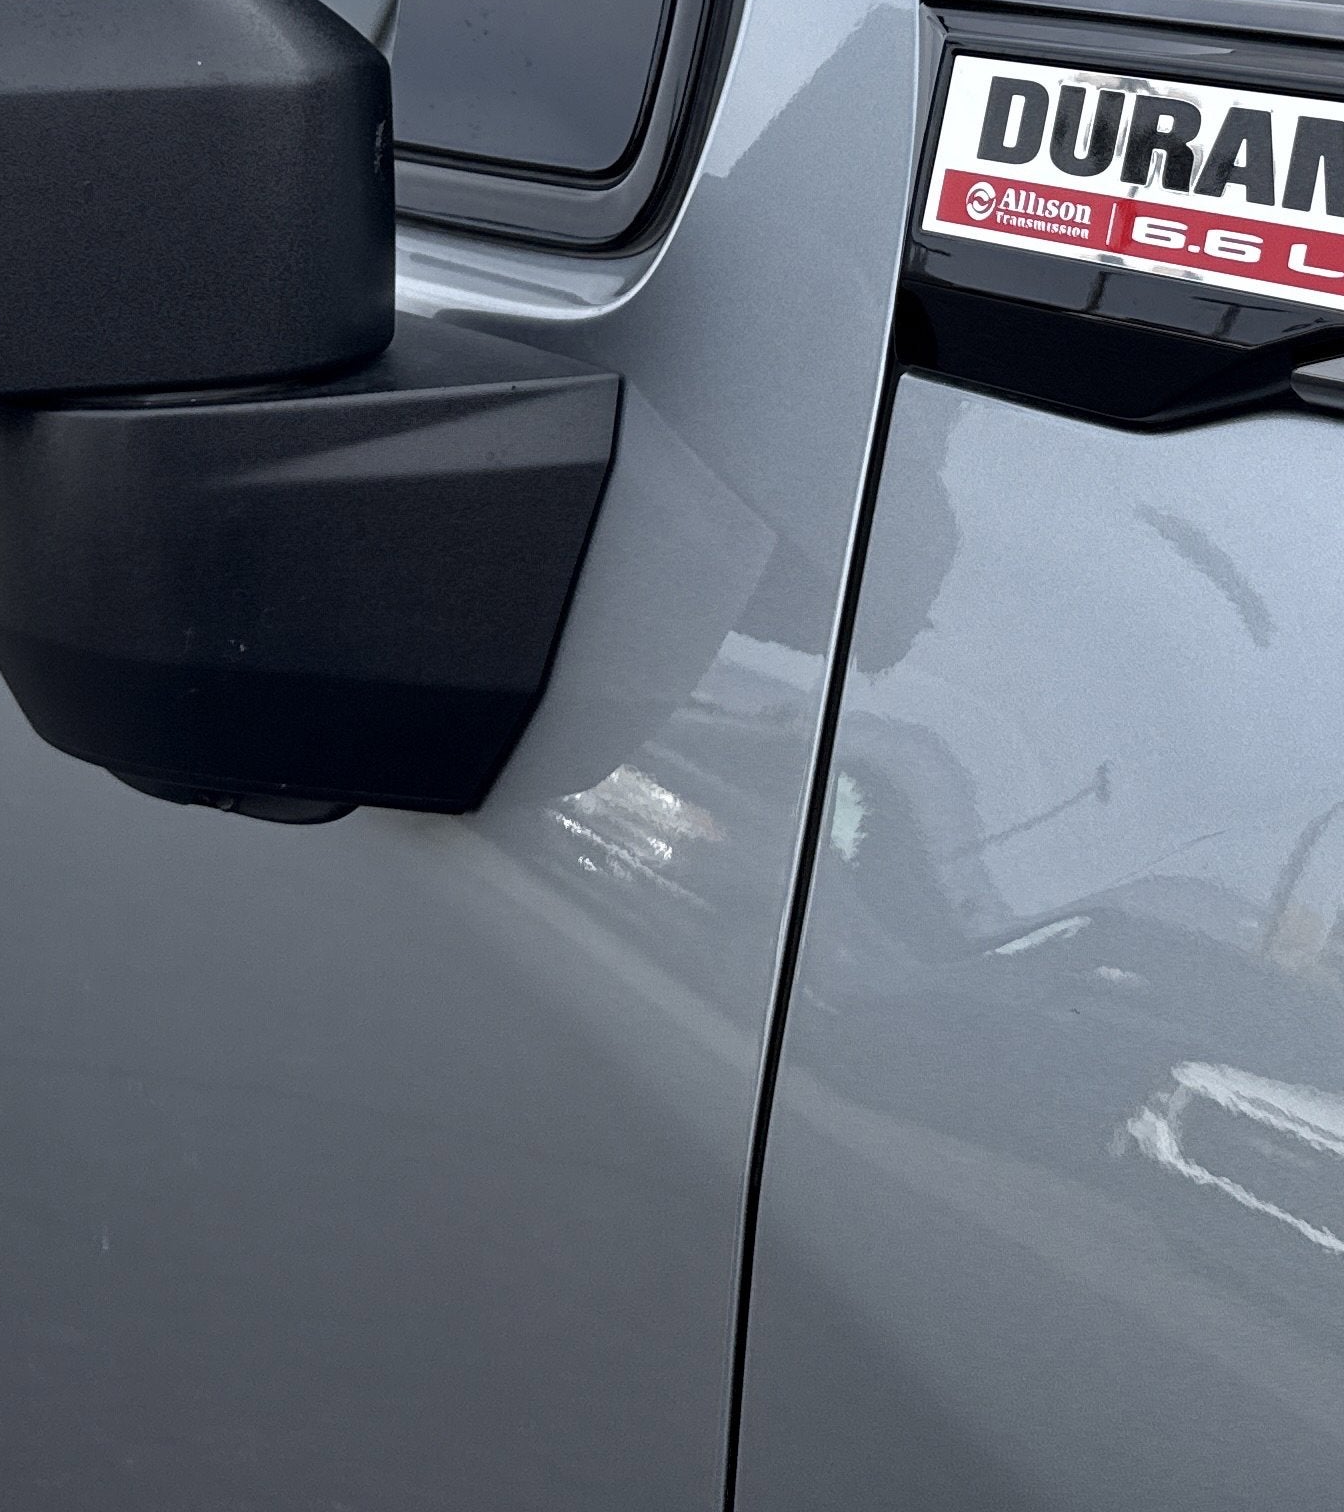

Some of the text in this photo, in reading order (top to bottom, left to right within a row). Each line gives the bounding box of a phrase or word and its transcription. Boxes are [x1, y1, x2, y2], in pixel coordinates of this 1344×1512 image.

[995, 212, 1090, 240] Transmission
[998, 186, 1092, 226] Allison
[1131, 216, 1264, 263] 6.6
